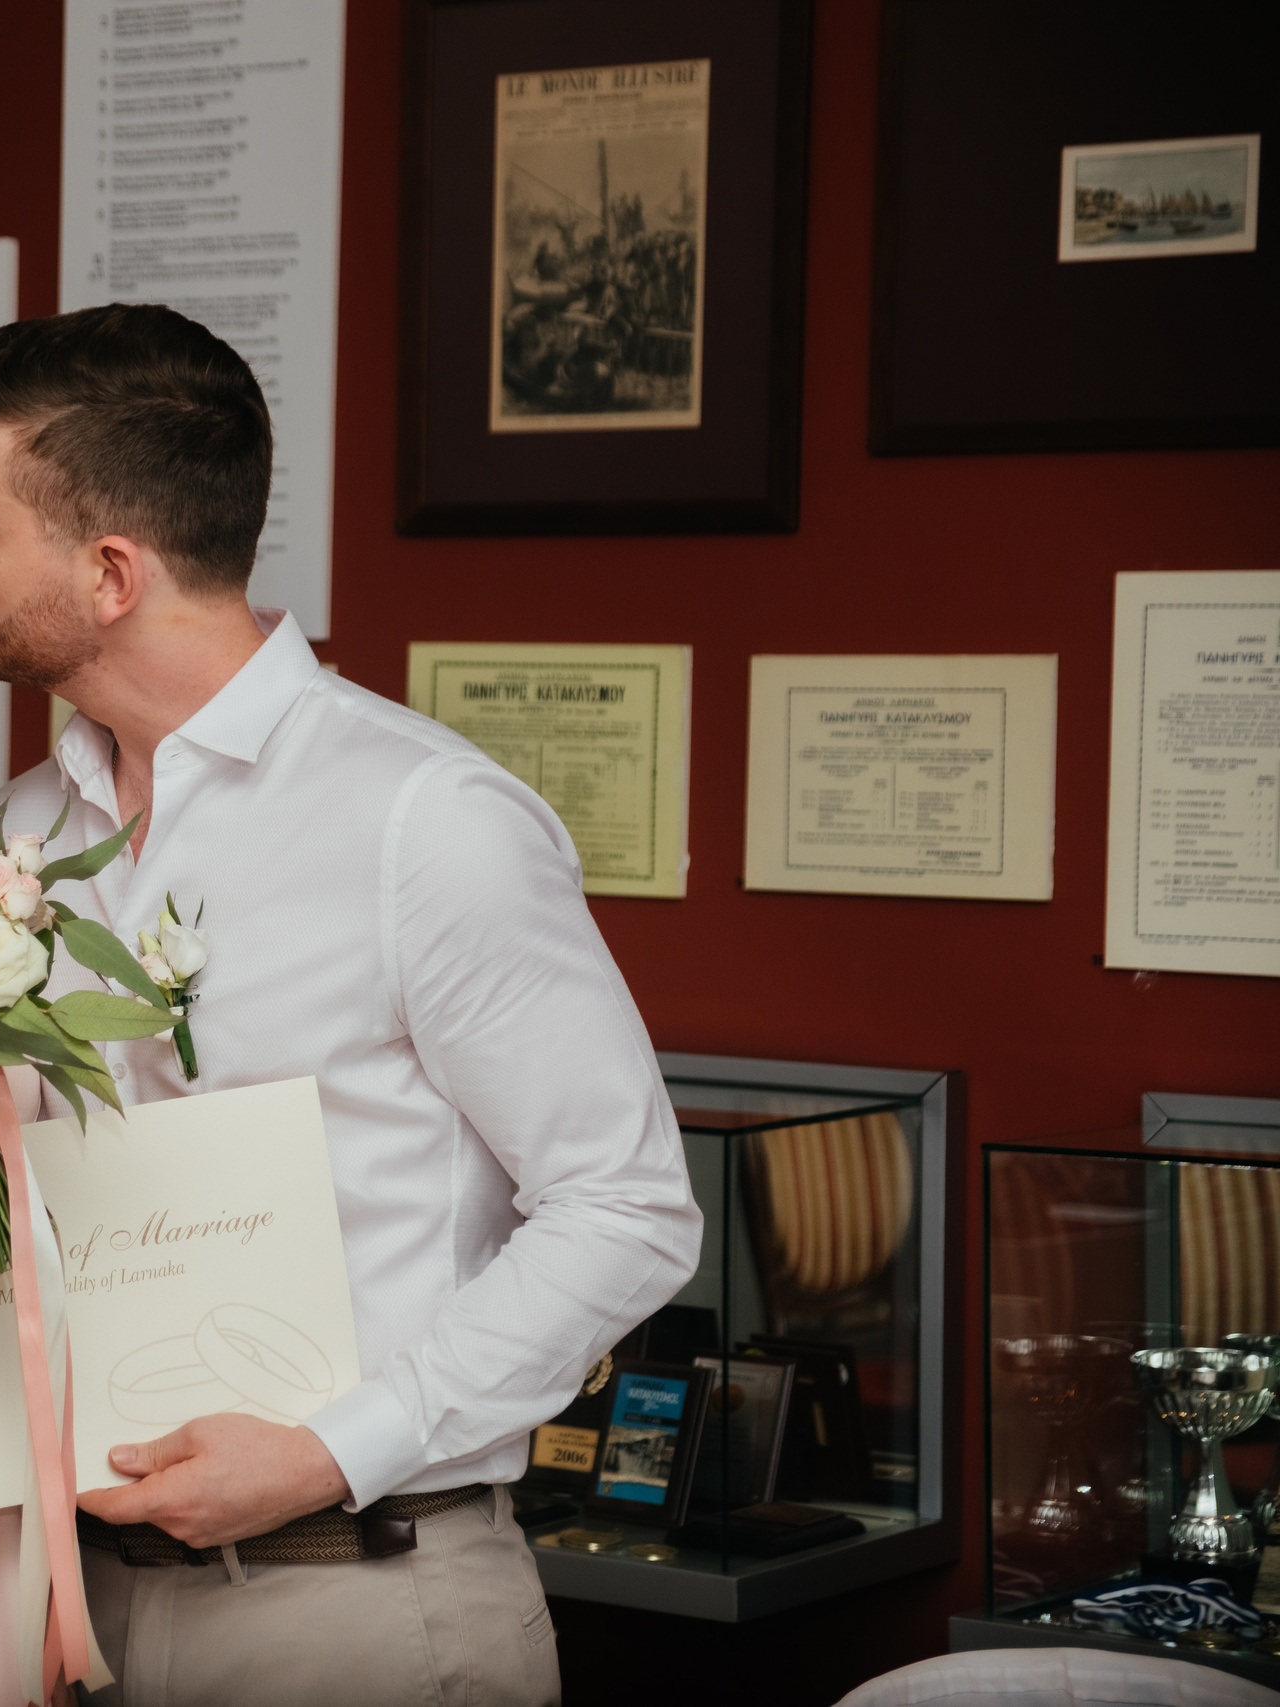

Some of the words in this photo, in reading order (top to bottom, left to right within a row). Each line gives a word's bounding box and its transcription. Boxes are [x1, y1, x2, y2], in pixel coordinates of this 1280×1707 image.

[506, 75, 529, 98] LE
[540, 69, 602, 94] MONDE
[68, 1223, 104, 1272] of
[109, 1208, 275, 1252] Marriage
[100, 1269, 117, 1293] of
[120, 1260, 186, 1285] Larnaka
[553, 1447, 589, 1466] 2006
